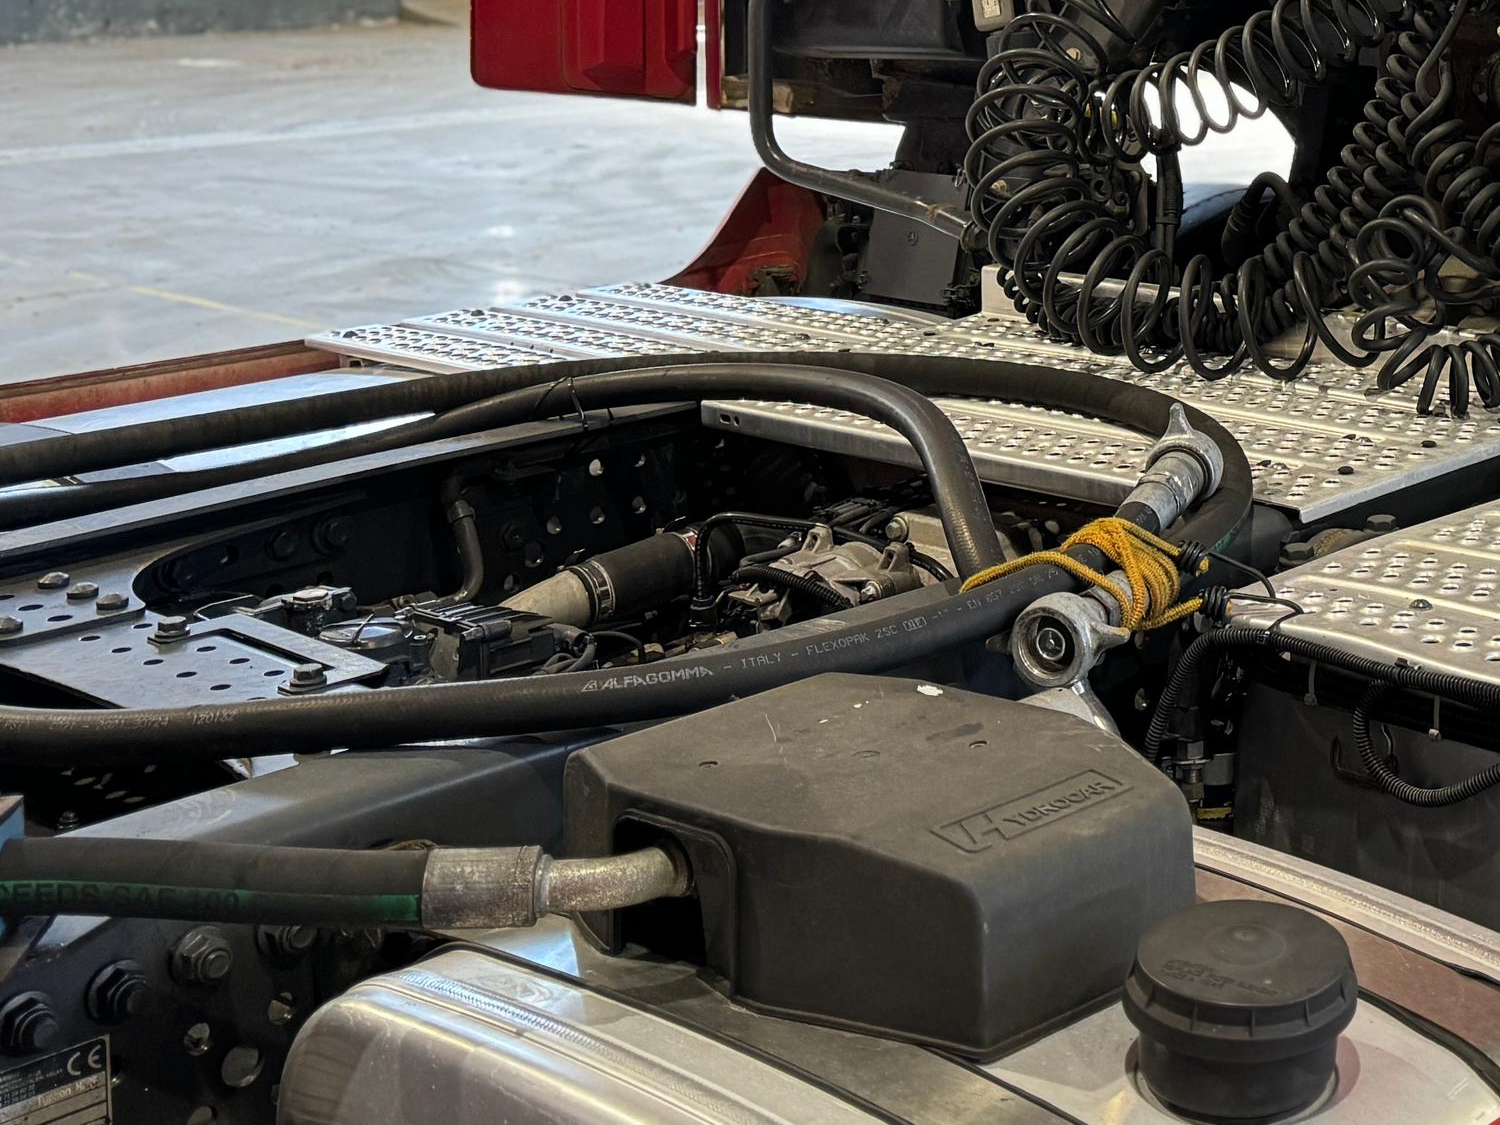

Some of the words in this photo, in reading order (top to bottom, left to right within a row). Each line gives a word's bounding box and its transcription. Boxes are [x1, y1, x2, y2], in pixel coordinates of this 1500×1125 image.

[602, 665, 713, 691] ALFAGOMMA
[740, 651, 782, 670] ITALY
[805, 632, 871, 656] FLEXOPAK
